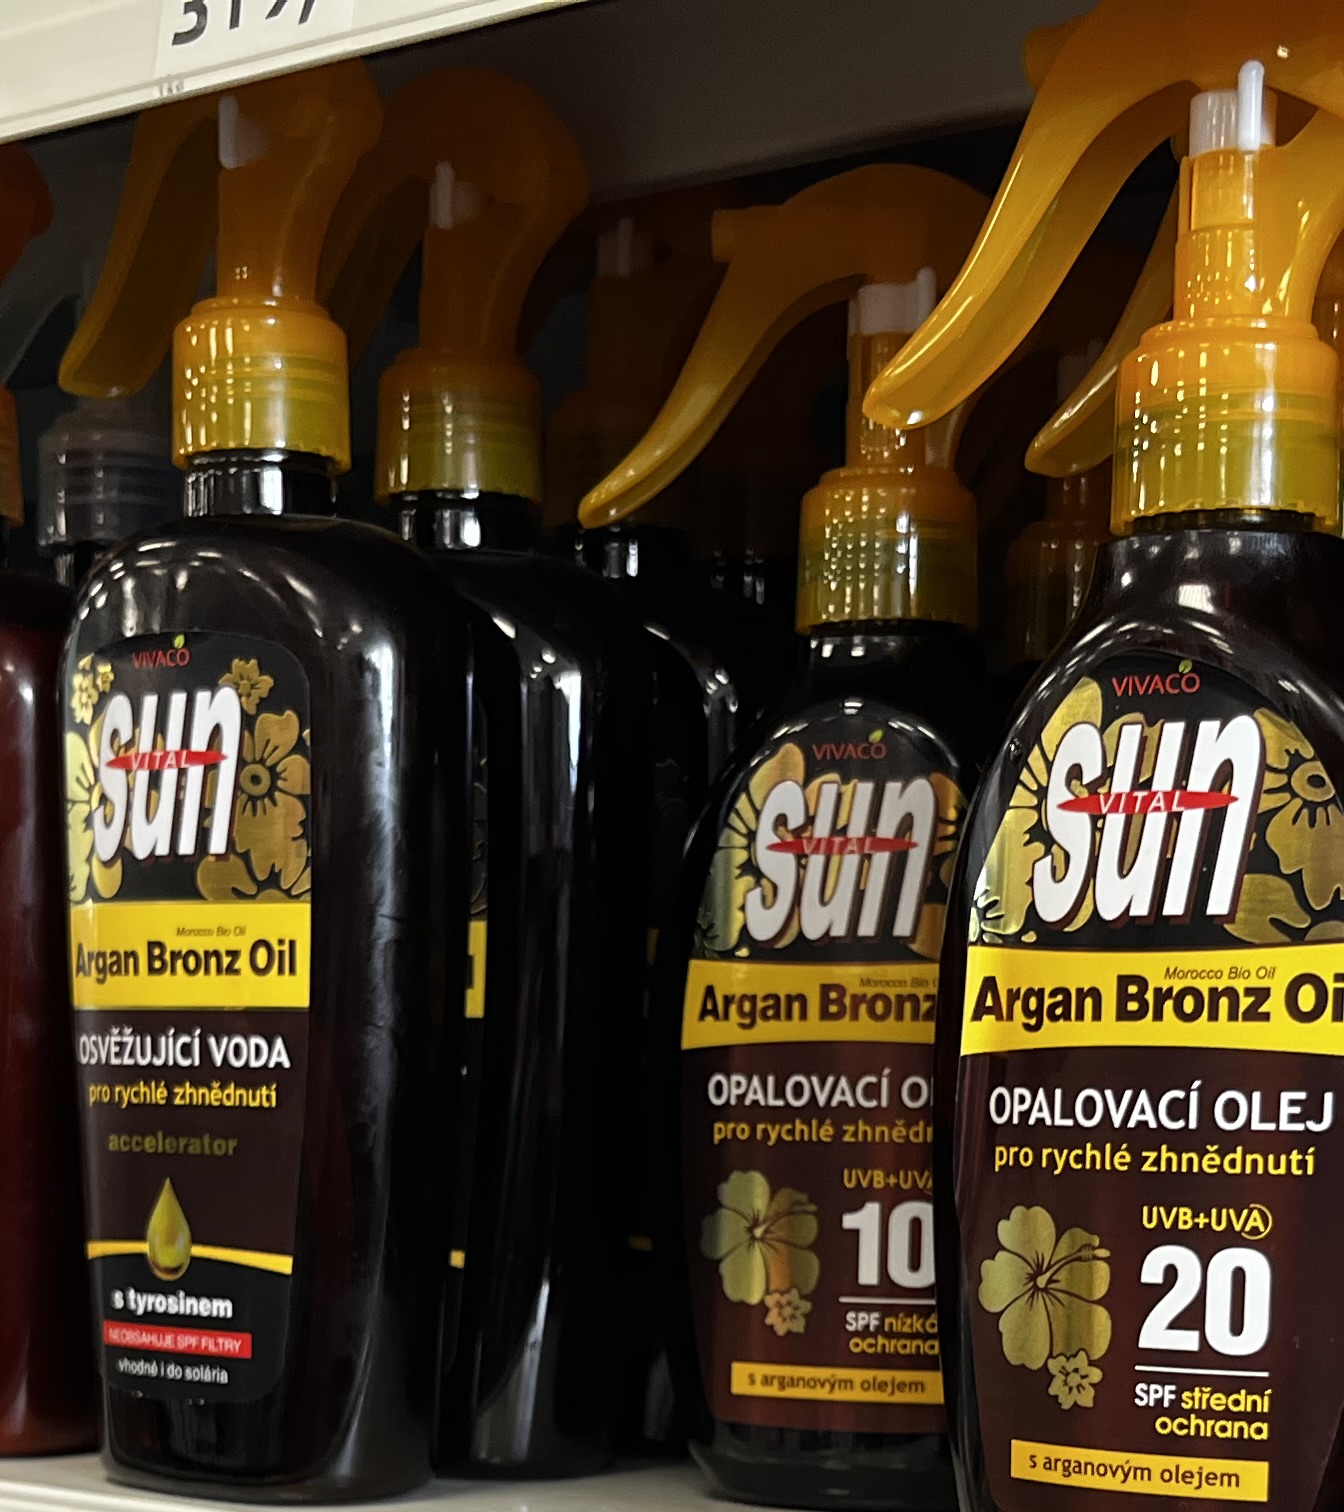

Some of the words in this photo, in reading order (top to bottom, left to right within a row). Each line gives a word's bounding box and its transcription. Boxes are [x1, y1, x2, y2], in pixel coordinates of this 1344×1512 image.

[132, 647, 191, 669] VIVACO
[1112, 673, 1200, 697] VIVACO
[128, 751, 192, 772] VITAL
[812, 742, 887, 761] VIVACO
[95, 687, 243, 864] sun
[1099, 791, 1185, 814] VITAL
[1032, 715, 1265, 929] sun
[804, 836, 879, 854] VITAL
[746, 779, 937, 945] sun
[74, 941, 141, 983] Argan
[147, 940, 242, 977] Bronz
[250, 940, 298, 977] Oil
[1164, 966, 1224, 980] Morocco
[1228, 966, 1252, 980] Bio
[1255, 966, 1275, 980] Oil
[697, 984, 809, 1028] Argan
[970, 975, 1103, 1032] Argan
[1116, 975, 1271, 1022] Bronz
[78, 1025, 201, 1066] OSVĚŽUJÍCÍ
[208, 1036, 291, 1070] VODA
[88, 1083, 111, 1109] pro
[114, 1080, 168, 1109] rychlé
[173, 1082, 278, 1109] zhnědnutí
[708, 1069, 893, 1109] OPALOVACÍ
[989, 1081, 1203, 1129] OPALOVACÍ
[1214, 1092, 1335, 1133] OLEJ
[108, 1132, 238, 1156] accelerator
[712, 1122, 749, 1145] pro
[755, 1121, 836, 1146] rychlé
[994, 1145, 1032, 1172] pro
[1041, 1143, 1131, 1175] rychlé
[1141, 1144, 1316, 1176] zhnědnutí
[1141, 1203, 1273, 1239] UVB+UVA
[842, 1201, 938, 1289] 10
[111, 1289, 124, 1309] s
[126, 1287, 233, 1318] tyrosinem
[1138, 1244, 1272, 1356] 20
[760, 1372, 855, 1393] arganovým
[860, 1375, 925, 1395] olejem
[1134, 1383, 1175, 1408] SPF
[1181, 1385, 1272, 1414] střední
[1155, 1414, 1268, 1440] ochrana
[1029, 1454, 1037, 1470] s
[1043, 1454, 1152, 1483] arganovým
[1160, 1464, 1240, 1489] olejem
